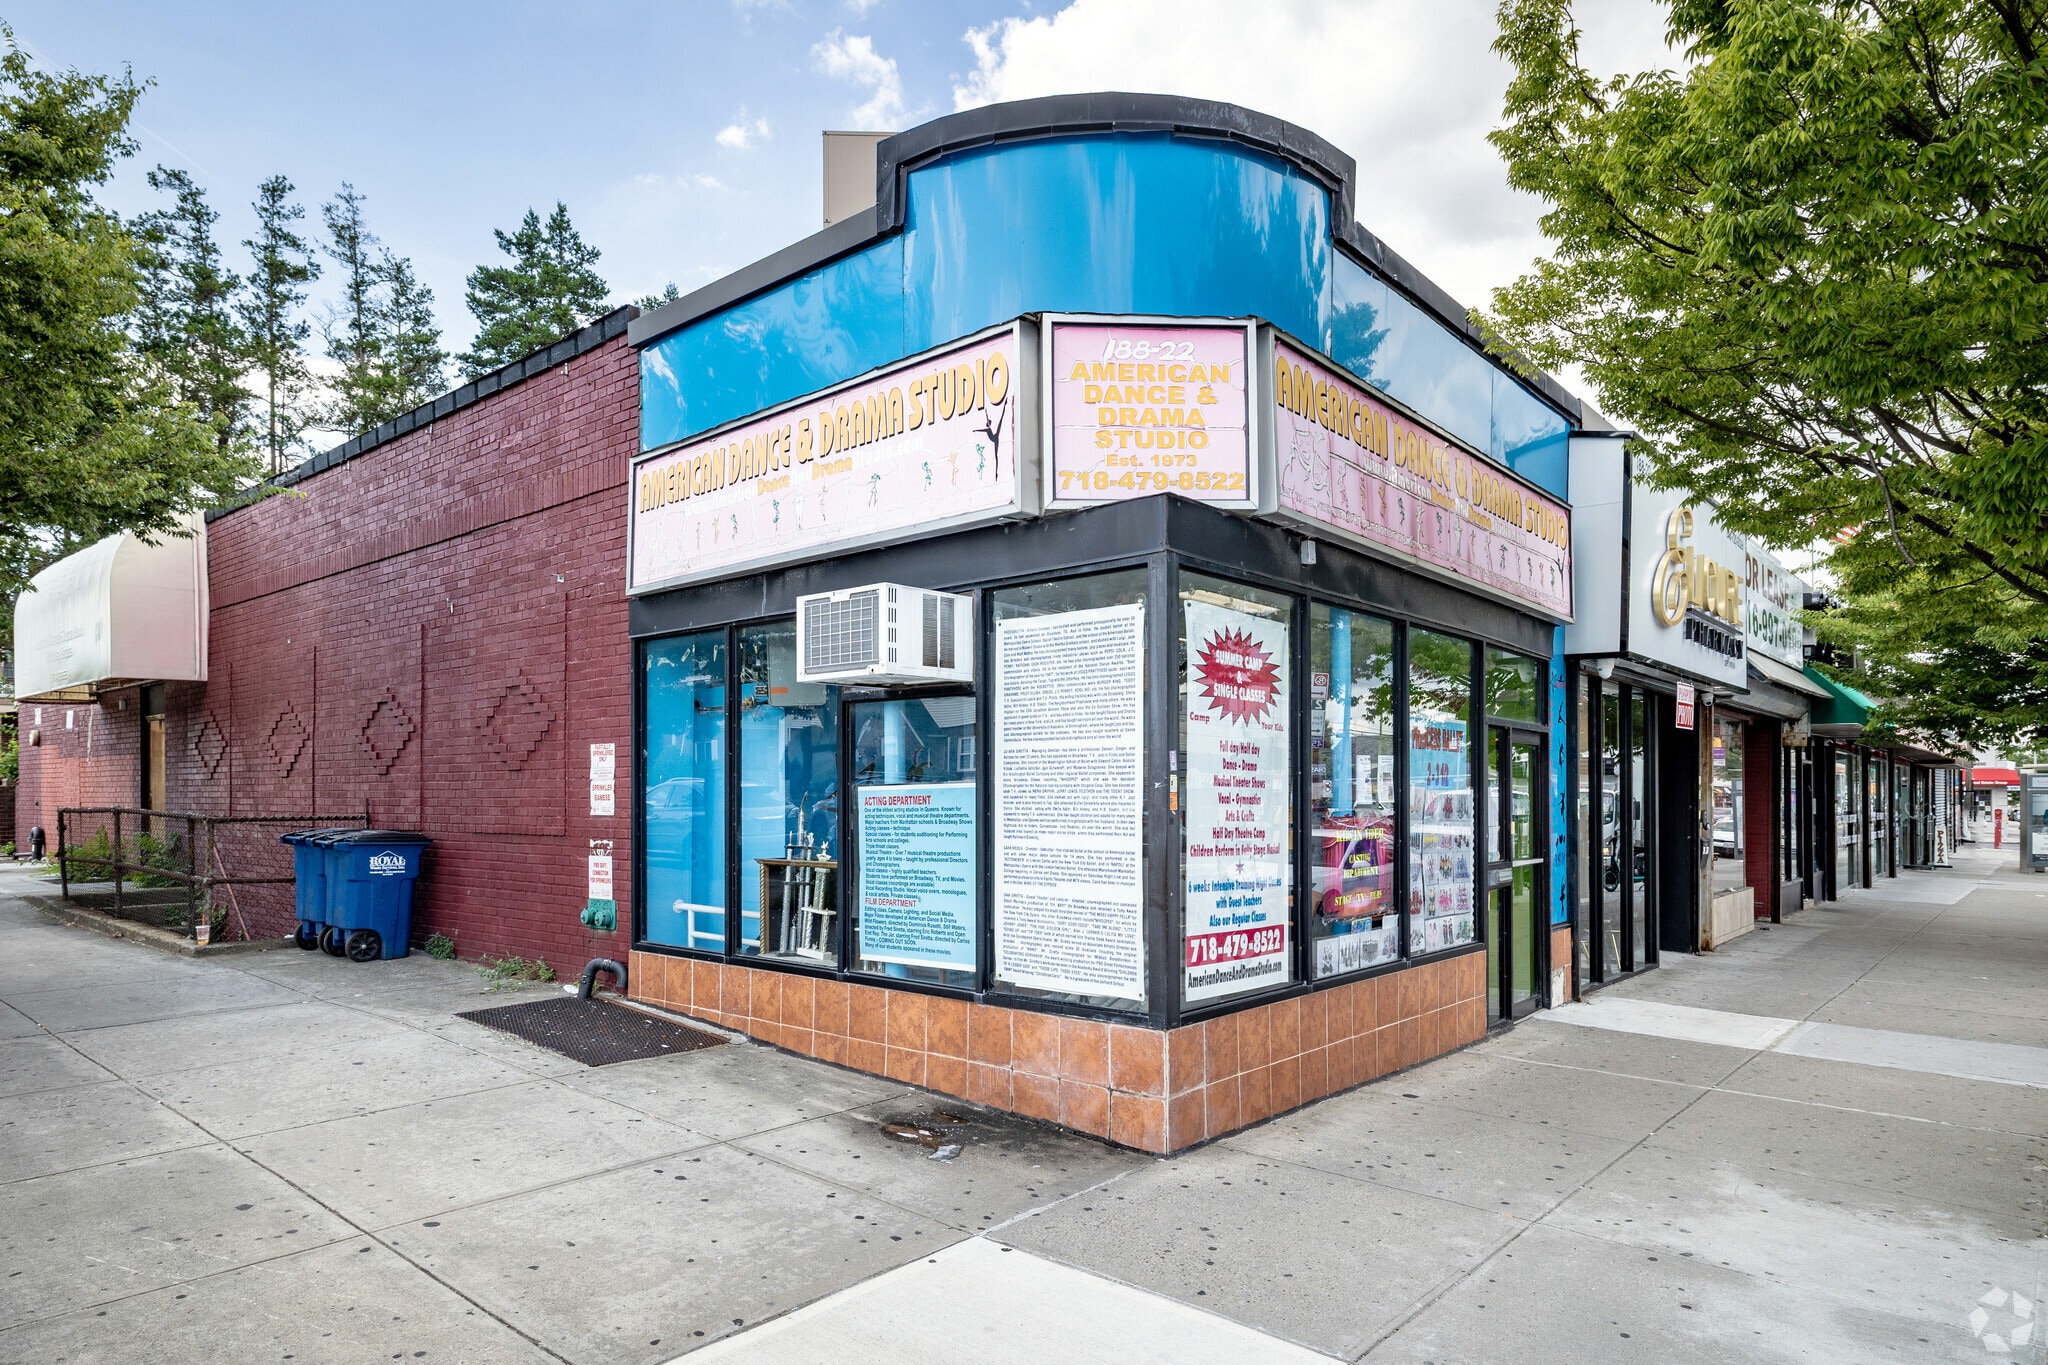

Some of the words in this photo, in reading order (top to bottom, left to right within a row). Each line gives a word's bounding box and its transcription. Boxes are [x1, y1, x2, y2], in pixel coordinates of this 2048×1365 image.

[1104, 339, 1195, 361] 188-22
[1070, 362, 1231, 383] AMERICAN
[1084, 385, 1186, 404] DANCE
[1197, 386, 1219, 405] &
[1098, 407, 1207, 427] DRAMA
[640, 447, 726, 514] AMERICAN
[728, 424, 792, 485] DANCE
[796, 418, 814, 464] &
[819, 387, 904, 459] DRAMA
[909, 351, 1010, 431] STUDIO
[1095, 430, 1209, 449] STUDIO
[1106, 454, 1144, 467] Est.
[1151, 454, 1198, 467] 1973
[1276, 356, 1389, 461] AMERICAN
[1393, 421, 1451, 493] DANCE
[1455, 457, 1469, 501] &
[1471, 465, 1523, 529] DRAMA
[1525, 496, 1568, 551] STUDIO
[1058, 471, 1245, 490] 718-479-8522
[1762, 564, 1791, 612] LEASE
[1215, 650, 1243, 668] SUMMER
[1245, 656, 1262, 671] CAMP
[1237, 671, 1242, 684] &
[1213, 682, 1238, 700] SINGLE
[1239, 687, 1266, 703] CLASSES
[1189, 712, 1210, 724] Camp
[1261, 722, 1273, 731] Your
[1274, 723, 1284, 731] Kids
[1442, 728, 1464, 753] BALLET
[1220, 740, 1228, 752] Full
[1252, 743, 1260, 758] day
[1222, 757, 1237, 770] Dance
[1242, 759, 1257, 771] Drama
[592, 784, 612, 792] SPRINKLER
[1213, 774, 1231, 787] Musical
[1233, 776, 1251, 788] Theater
[1252, 776, 1266, 788] Shows
[864, 796, 887, 806] ACTING
[889, 795, 931, 806] DEPARTMENT
[1218, 792, 1231, 805] Vocal
[1236, 792, 1262, 808] Gymnastics
[1225, 810, 1235, 822] Arts
[1236, 810, 1240, 822] &
[1241, 809, 1255, 822] Crafts
[1213, 826, 1223, 840] Half
[1224, 827, 1234, 842] Day
[1235, 826, 1252, 839] Theatre
[1254, 826, 1266, 842] Camp
[1190, 844, 1214, 857] Children
[1215, 844, 1235, 857] Perform
[1236, 844, 1240, 856] in
[1254, 844, 1266, 858] Stage
[1937, 830, 1945, 863] PIZZA
[369, 856, 406, 866] ROYAL
[1349, 853, 1371, 864] CASTING
[1343, 866, 1379, 879] DEPARTMENT
[1188, 880, 1192, 893] 6
[1193, 879, 1211, 893] weeks
[1212, 878, 1235, 892] Intensive
[1236, 878, 1255, 892] Training
[865, 897, 877, 905] FILM
[878, 898, 917, 908] DEPARTMENT
[1216, 896, 1227, 909] with
[1228, 896, 1242, 908] Guest
[1243, 894, 1262, 907] Teachers
[1335, 894, 1352, 906] STAGE
[1356, 892, 1365, 904] TV
[1209, 914, 1221, 927] Also
[1222, 916, 1231, 926] our
[1232, 912, 1251, 928] Regular
[1252, 910, 1267, 922] Classes
[1190, 928, 1281, 963] 718-479-8522
[1188, 959, 1282, 989] AmericanDanceAndDramaStudio.com
